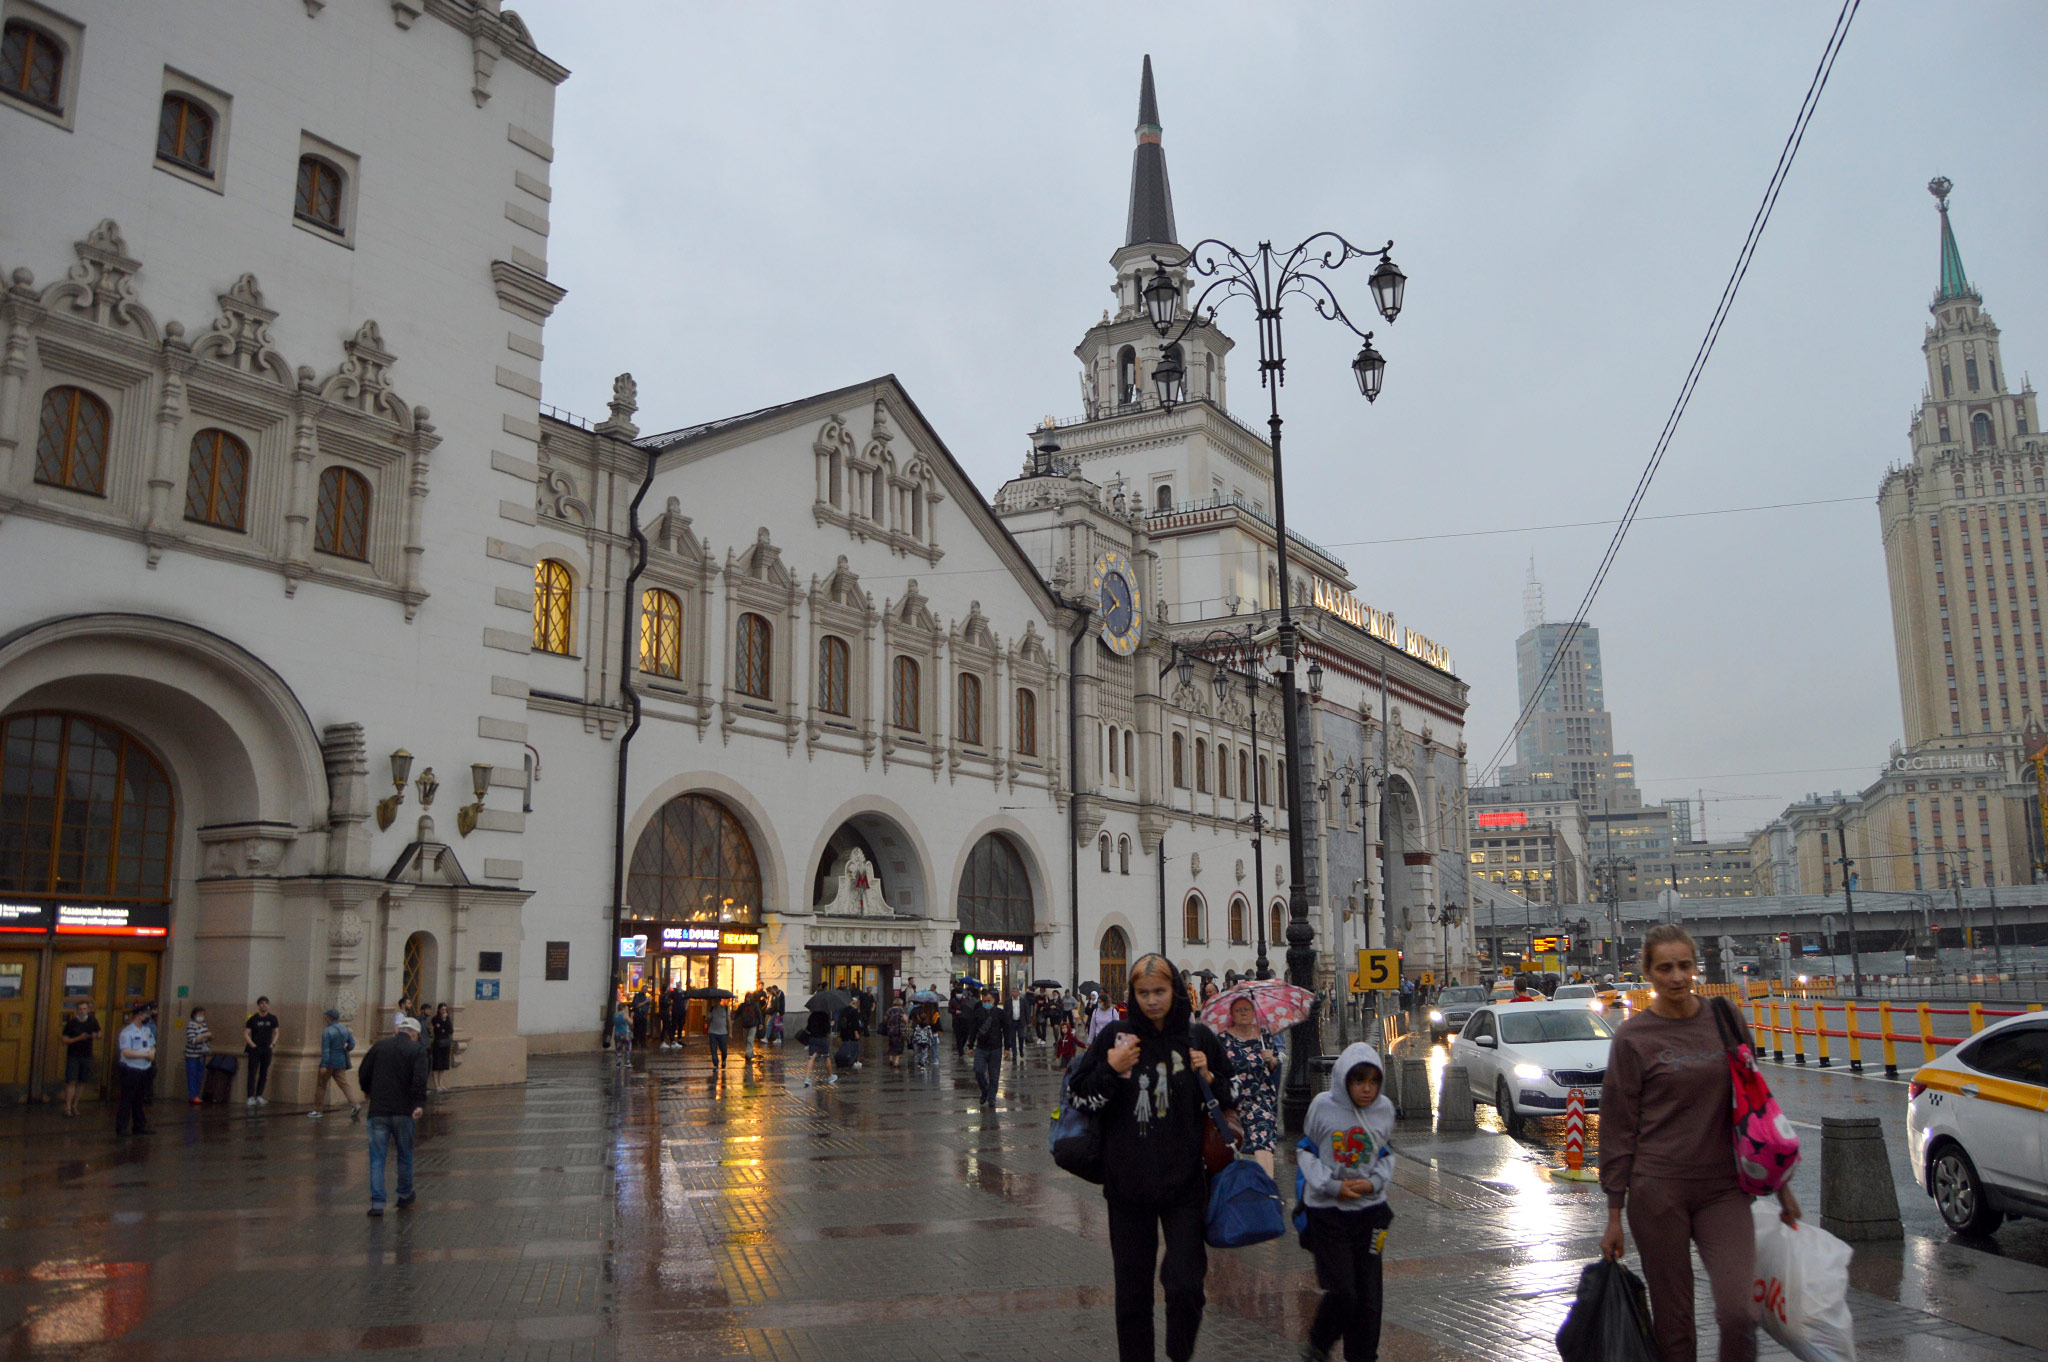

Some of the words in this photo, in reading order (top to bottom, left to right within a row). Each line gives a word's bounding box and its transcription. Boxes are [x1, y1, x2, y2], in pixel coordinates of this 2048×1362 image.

[1313, 575, 1398, 646] КАЗАНСКИЙ
[1404, 626, 1450, 673] ВОКЗАЛ
[60, 905, 102, 916] Казанский
[102, 908, 129, 917] вокзал
[723, 933, 759, 945] ПЕКАРНЯ
[1370, 955, 1388, 983] 5
[1505, 967, 1511, 976] 2
[1424, 974, 1432, 983] 3
